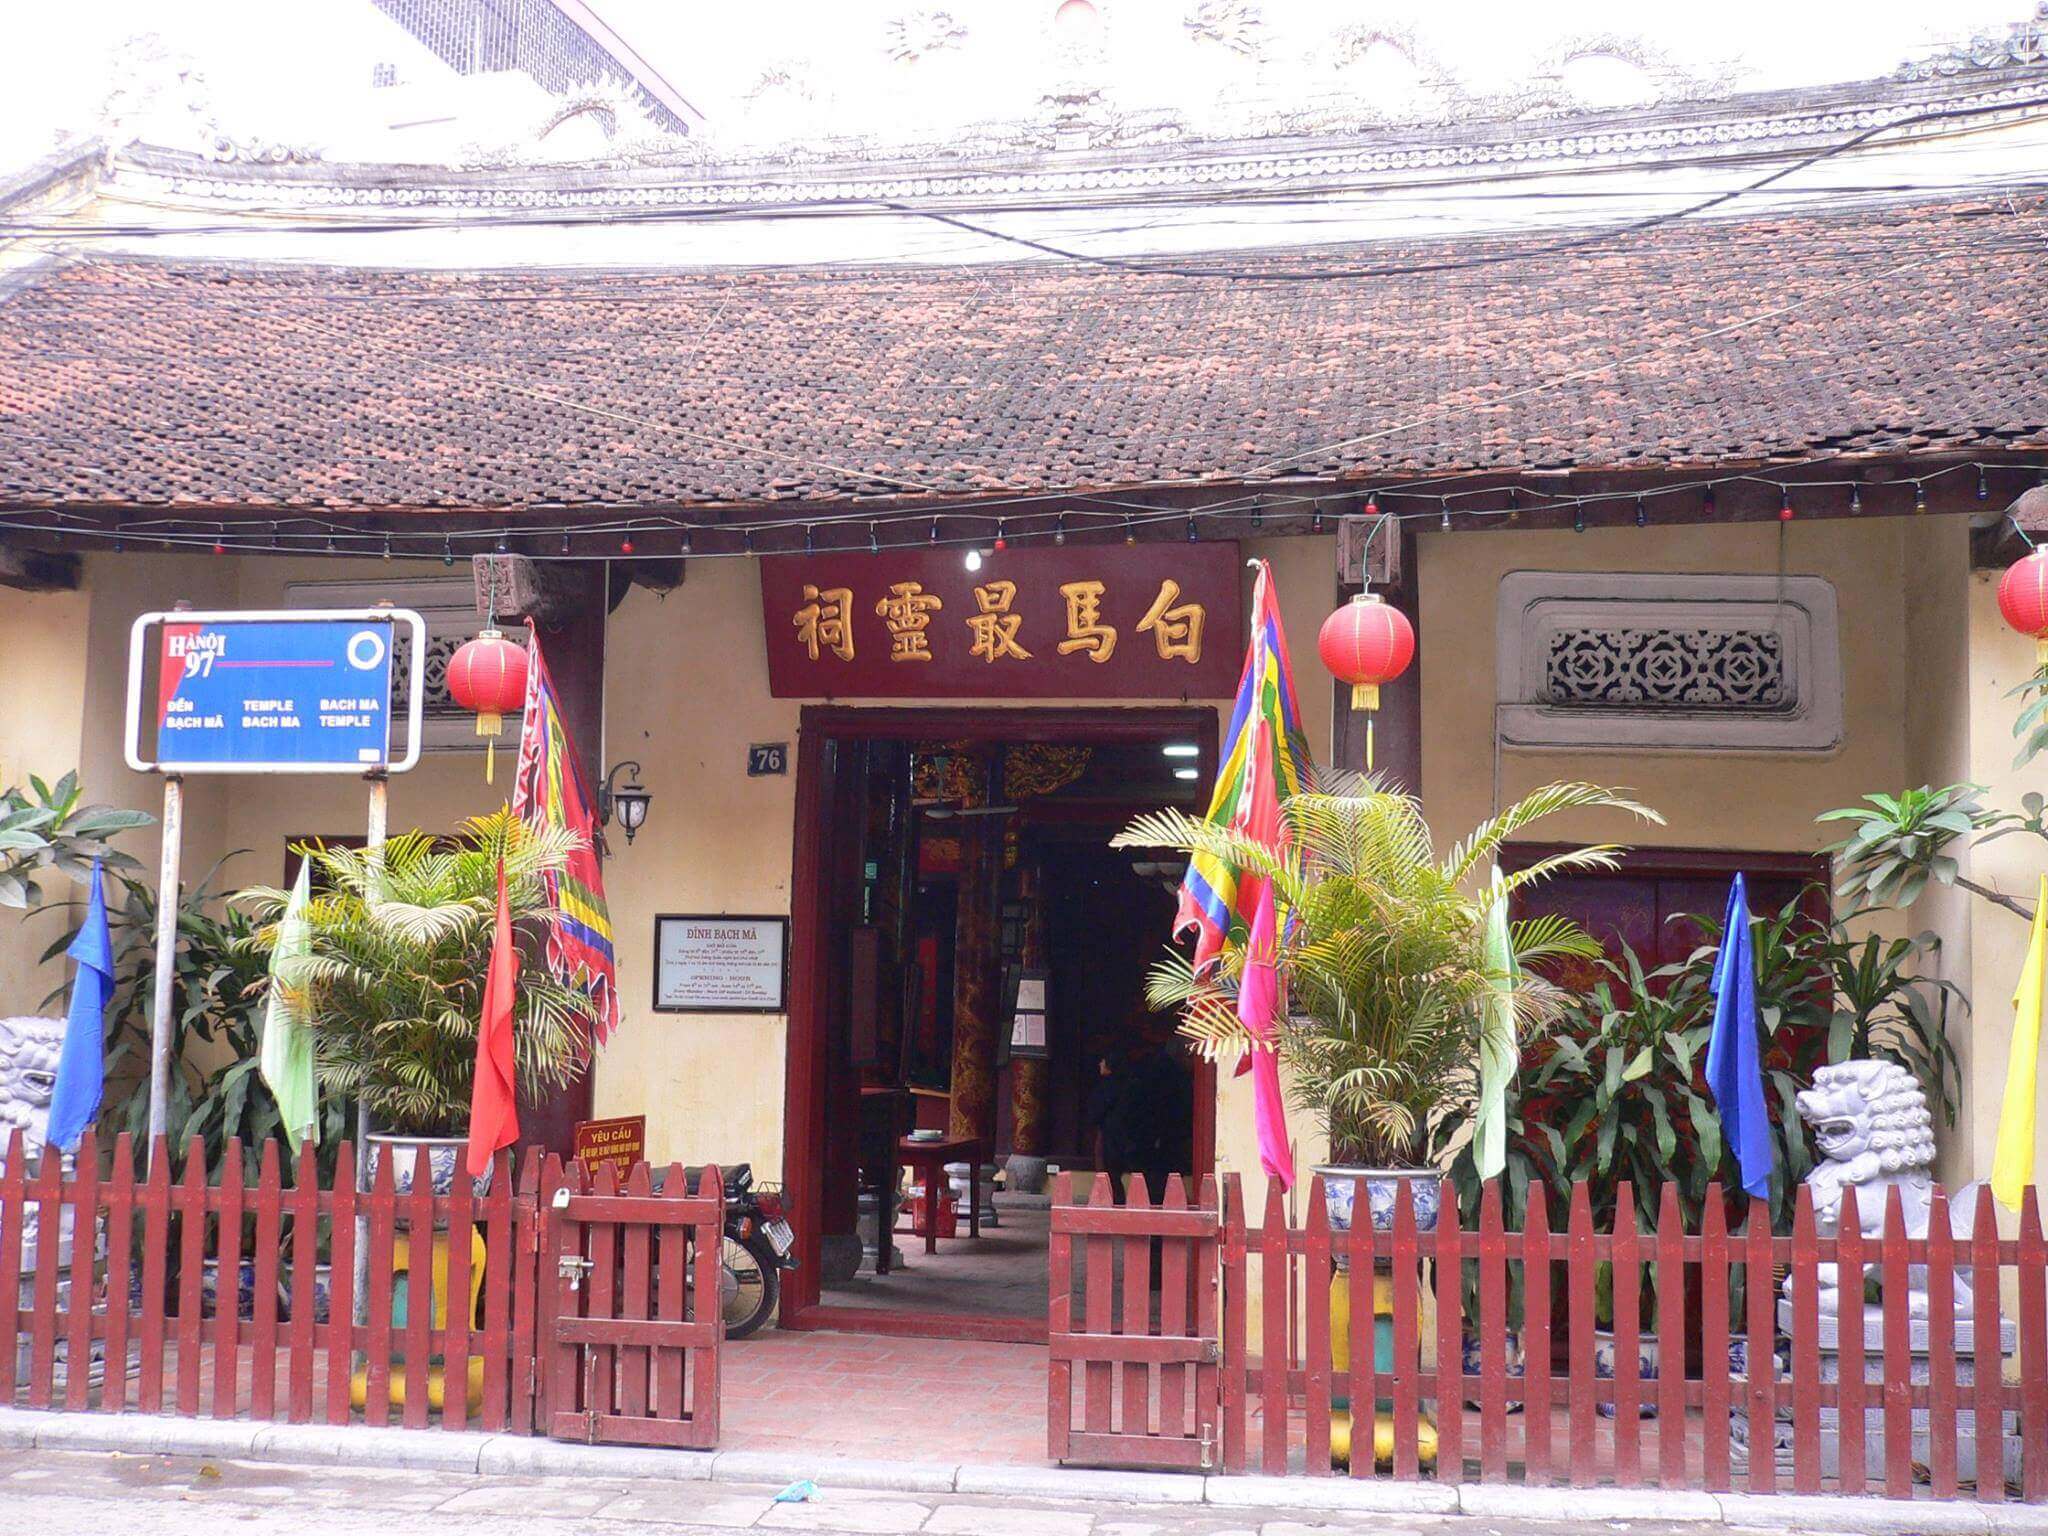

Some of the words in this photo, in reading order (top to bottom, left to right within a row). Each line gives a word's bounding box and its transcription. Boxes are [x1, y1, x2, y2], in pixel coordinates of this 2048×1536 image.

[184, 650, 216, 679] 97
[243, 699, 294, 711] TEMPLE
[320, 698, 357, 711] BACH
[359, 698, 380, 710] MA
[166, 716, 202, 731] BẠCH
[242, 715, 279, 728] BACH
[280, 716, 301, 728] MA
[319, 714, 371, 728] TEMPLE
[757, 749, 781, 770] 76
[591, 1130, 610, 1143] YÊU
